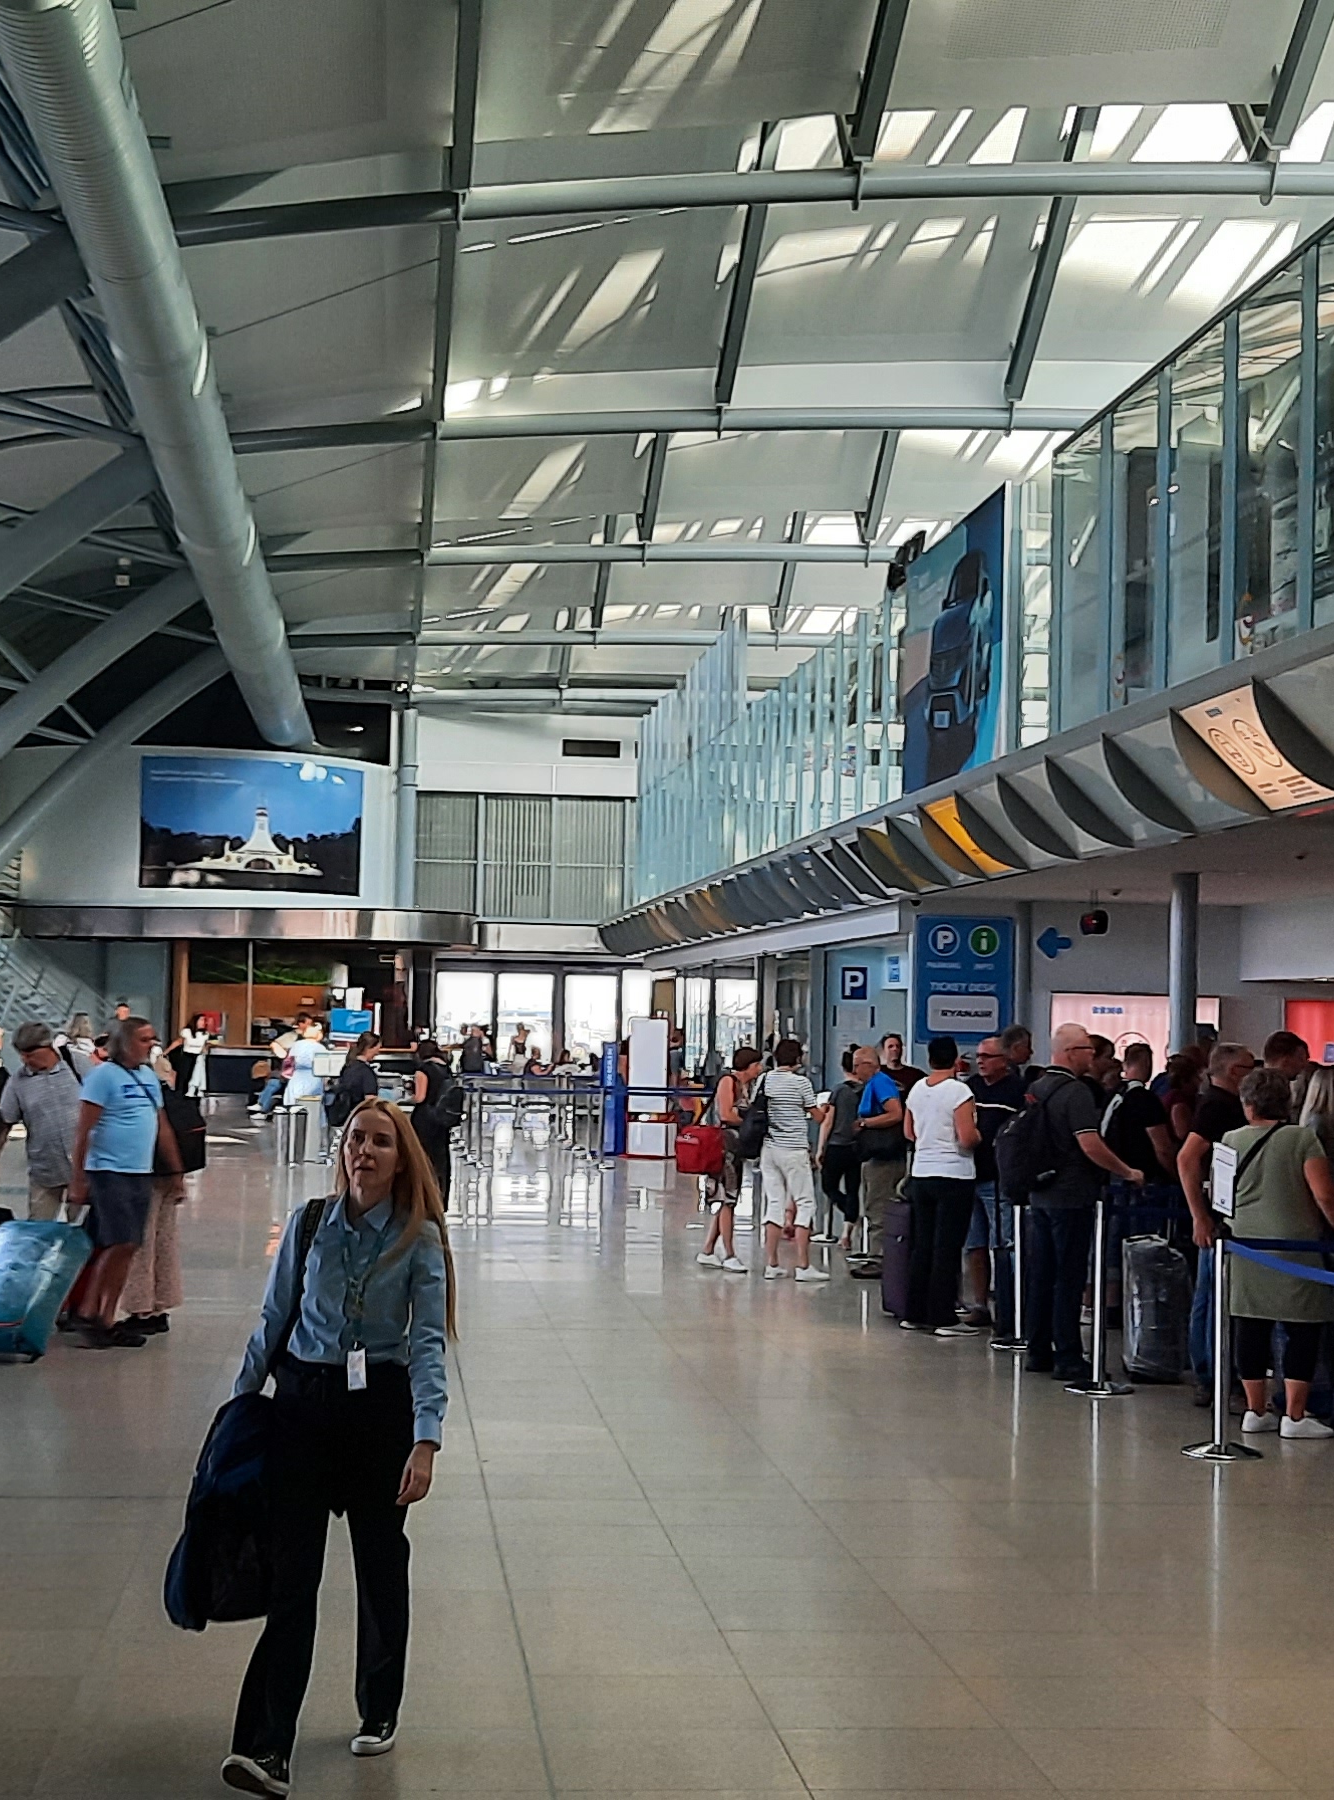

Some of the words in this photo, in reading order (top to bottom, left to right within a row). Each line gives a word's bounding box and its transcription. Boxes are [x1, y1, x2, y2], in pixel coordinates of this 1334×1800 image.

[937, 930, 955, 950] P
[843, 970, 865, 996] P
[940, 1009, 993, 1018] RYANAIR
